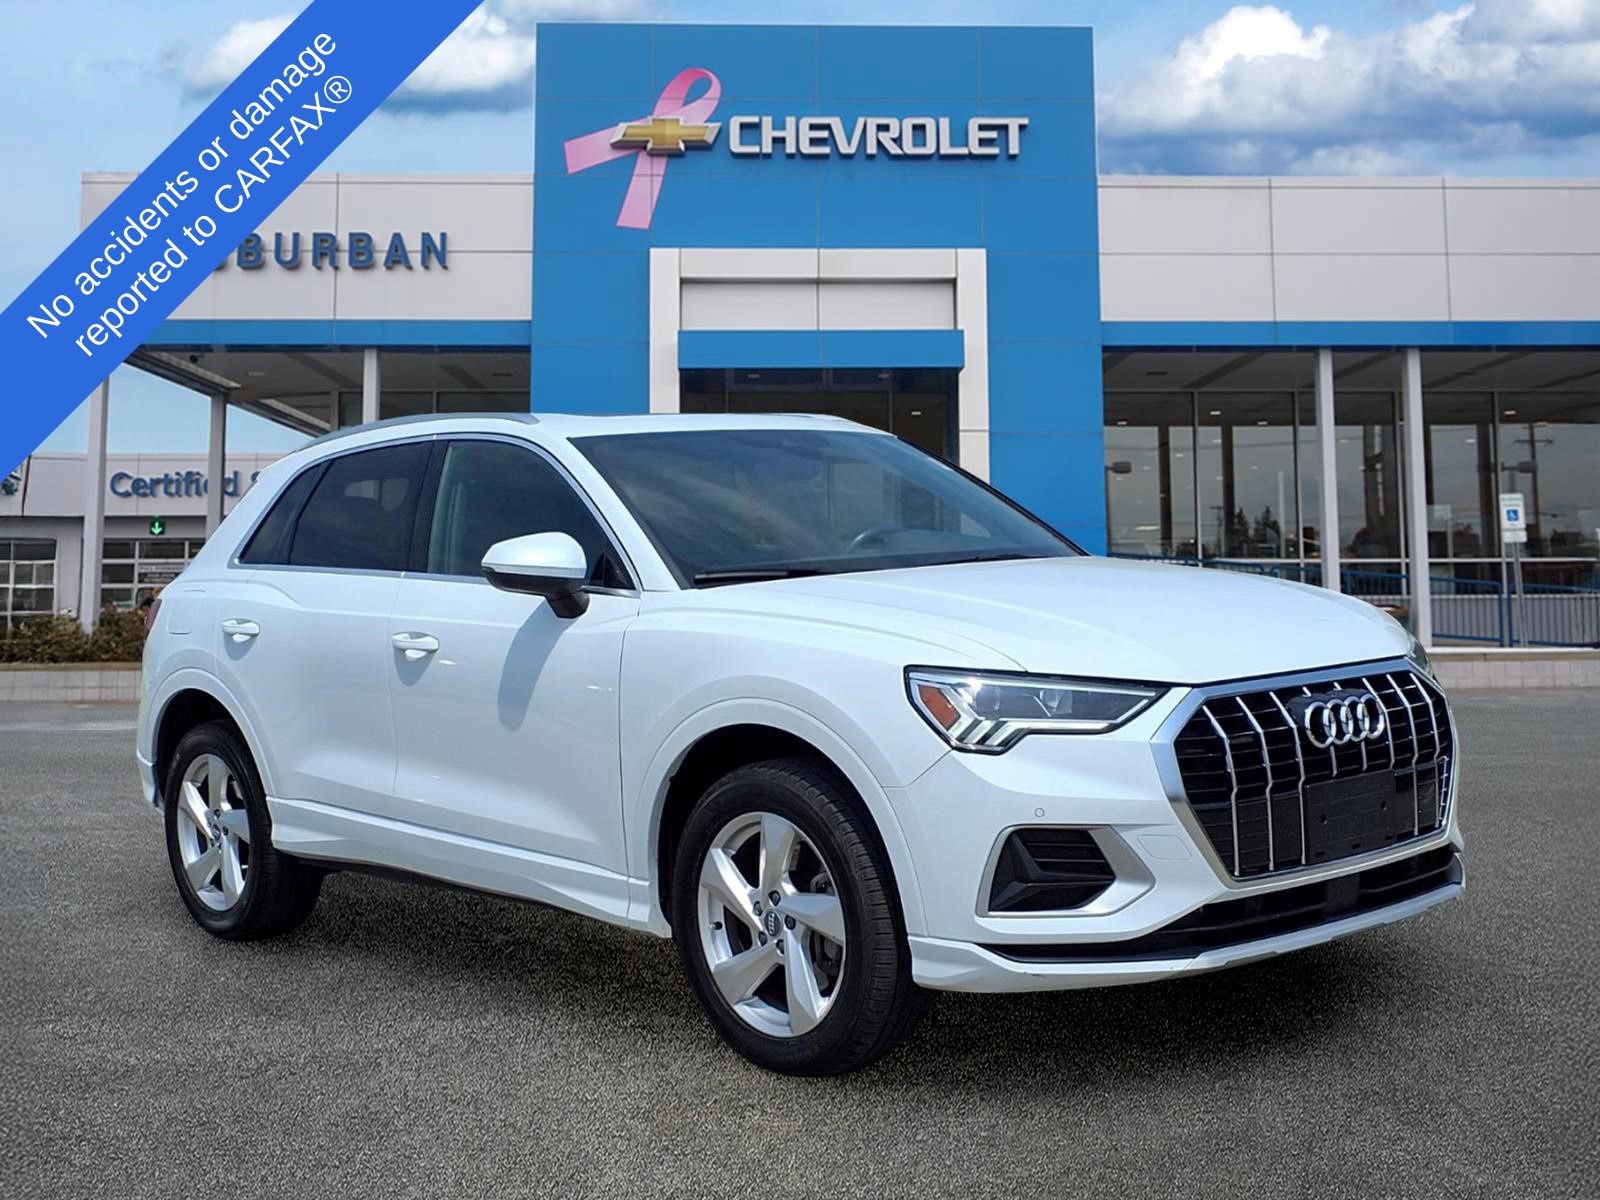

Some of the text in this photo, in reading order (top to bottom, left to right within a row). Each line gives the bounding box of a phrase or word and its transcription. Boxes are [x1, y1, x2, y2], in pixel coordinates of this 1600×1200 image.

[728, 115, 1029, 156] CHEVROLET
[214, 231, 449, 271] BURBAN
[109, 470, 241, 498] Certifid
